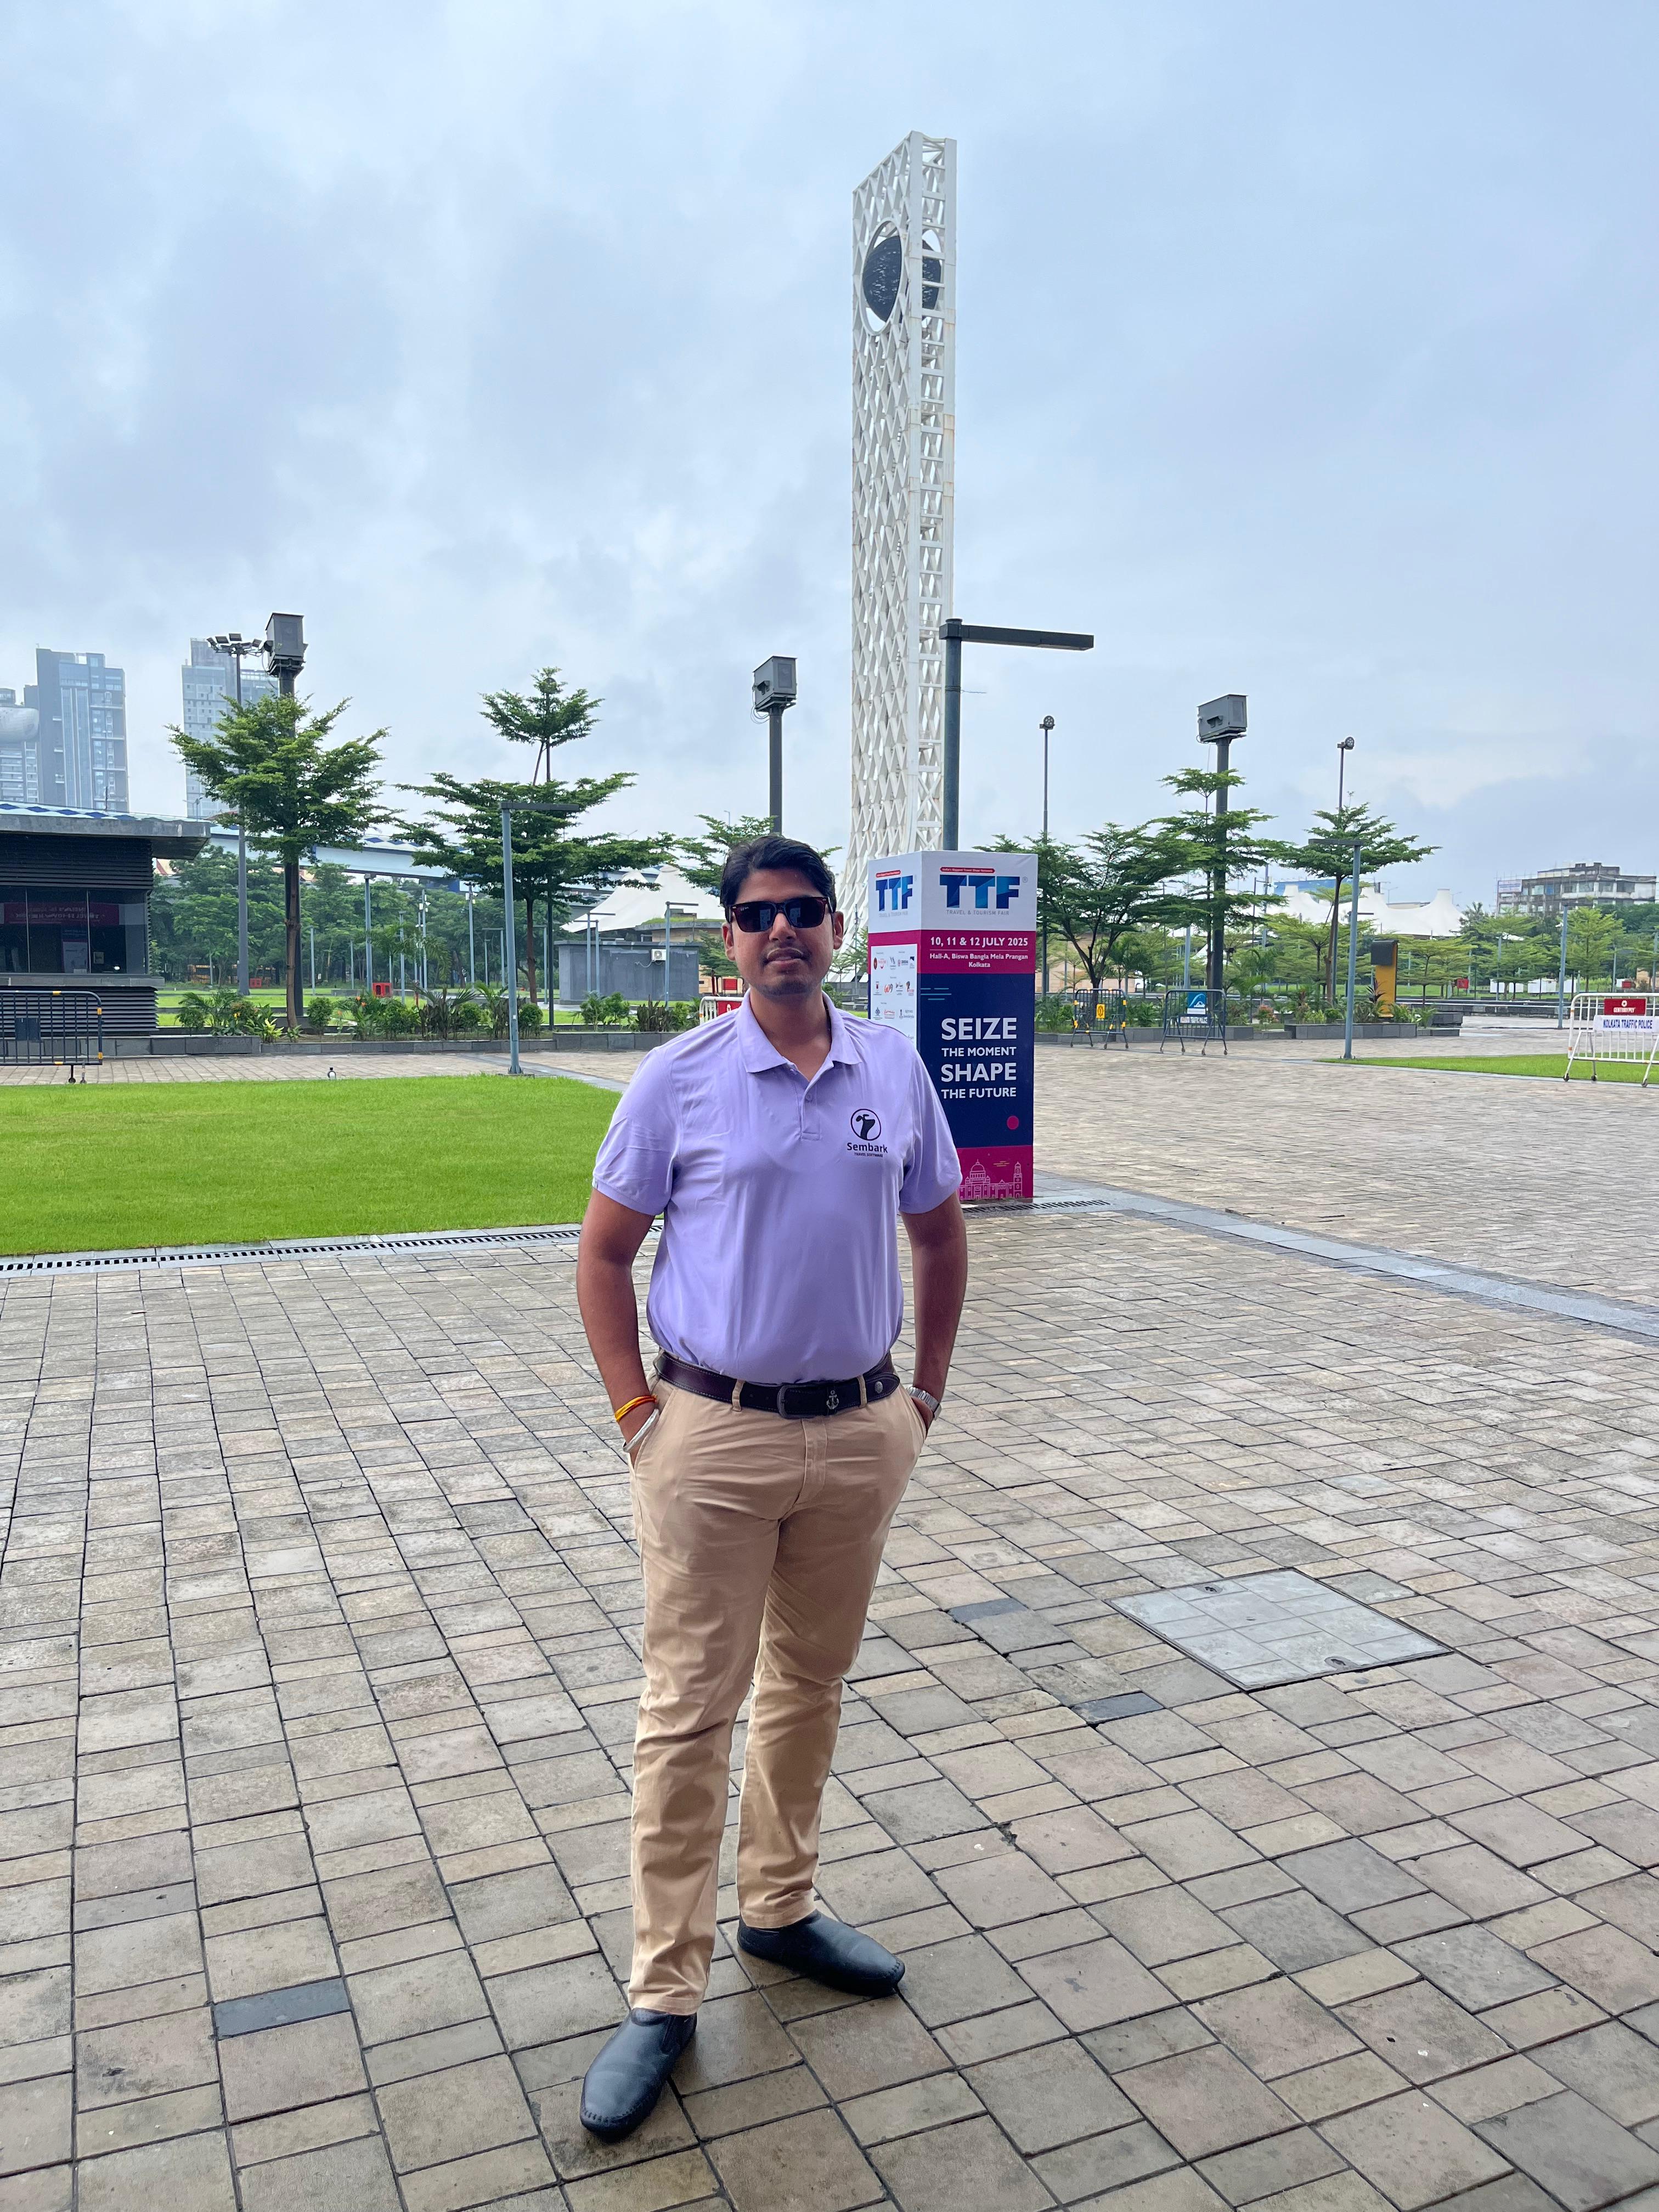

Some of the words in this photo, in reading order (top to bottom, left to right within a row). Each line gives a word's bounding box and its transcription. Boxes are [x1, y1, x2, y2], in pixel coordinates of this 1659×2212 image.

[876, 876, 913, 911] TTF
[940, 874, 1020, 909] TTF
[930, 936, 944, 947] 10,
[947, 936, 956, 946] 11
[960, 936, 967, 946] &
[970, 937, 980, 946] 12
[982, 937, 1005, 948] JULY
[1008, 938, 1028, 946] 2025
[941, 1018, 1017, 1040] SEIZE
[1603, 1019, 1620, 1029] KOLKATA
[1622, 1019, 1638, 1029] TRAFFIC
[1638, 1019, 1653, 1029] POLICE
[941, 1047, 964, 1057] THE
[967, 1047, 1017, 1057] MOMENT
[941, 1063, 1017, 1082] SHAPE
[941, 1089, 966, 1099] THE
[969, 1087, 1017, 1098] FUTURE
[847, 1142, 888, 1153] Sembark
